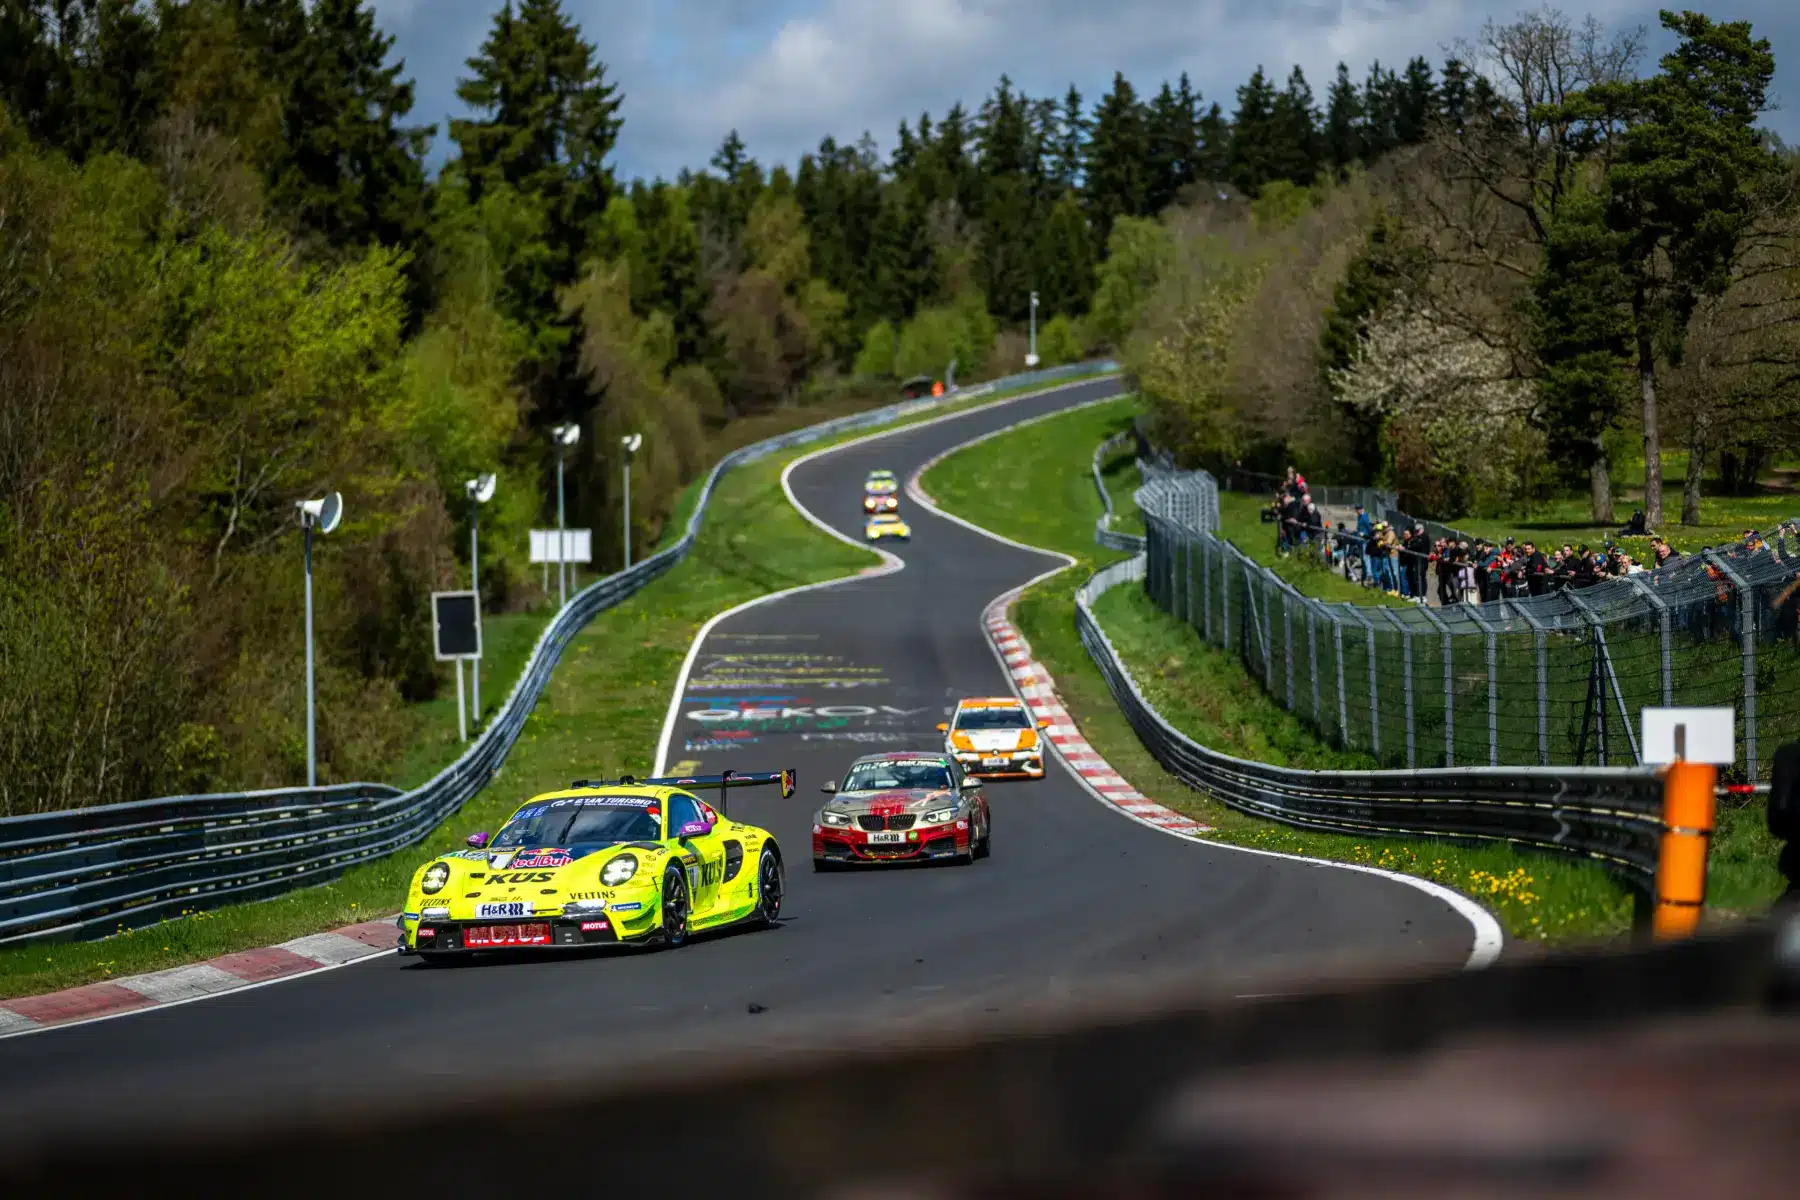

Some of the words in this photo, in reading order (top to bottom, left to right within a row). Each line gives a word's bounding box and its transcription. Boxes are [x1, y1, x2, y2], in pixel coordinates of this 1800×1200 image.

[605, 797, 652, 806] TURISMO
[569, 891, 616, 900] VELTINS
[481, 904, 507, 916] H&R
[582, 922, 608, 930] MOTUL
